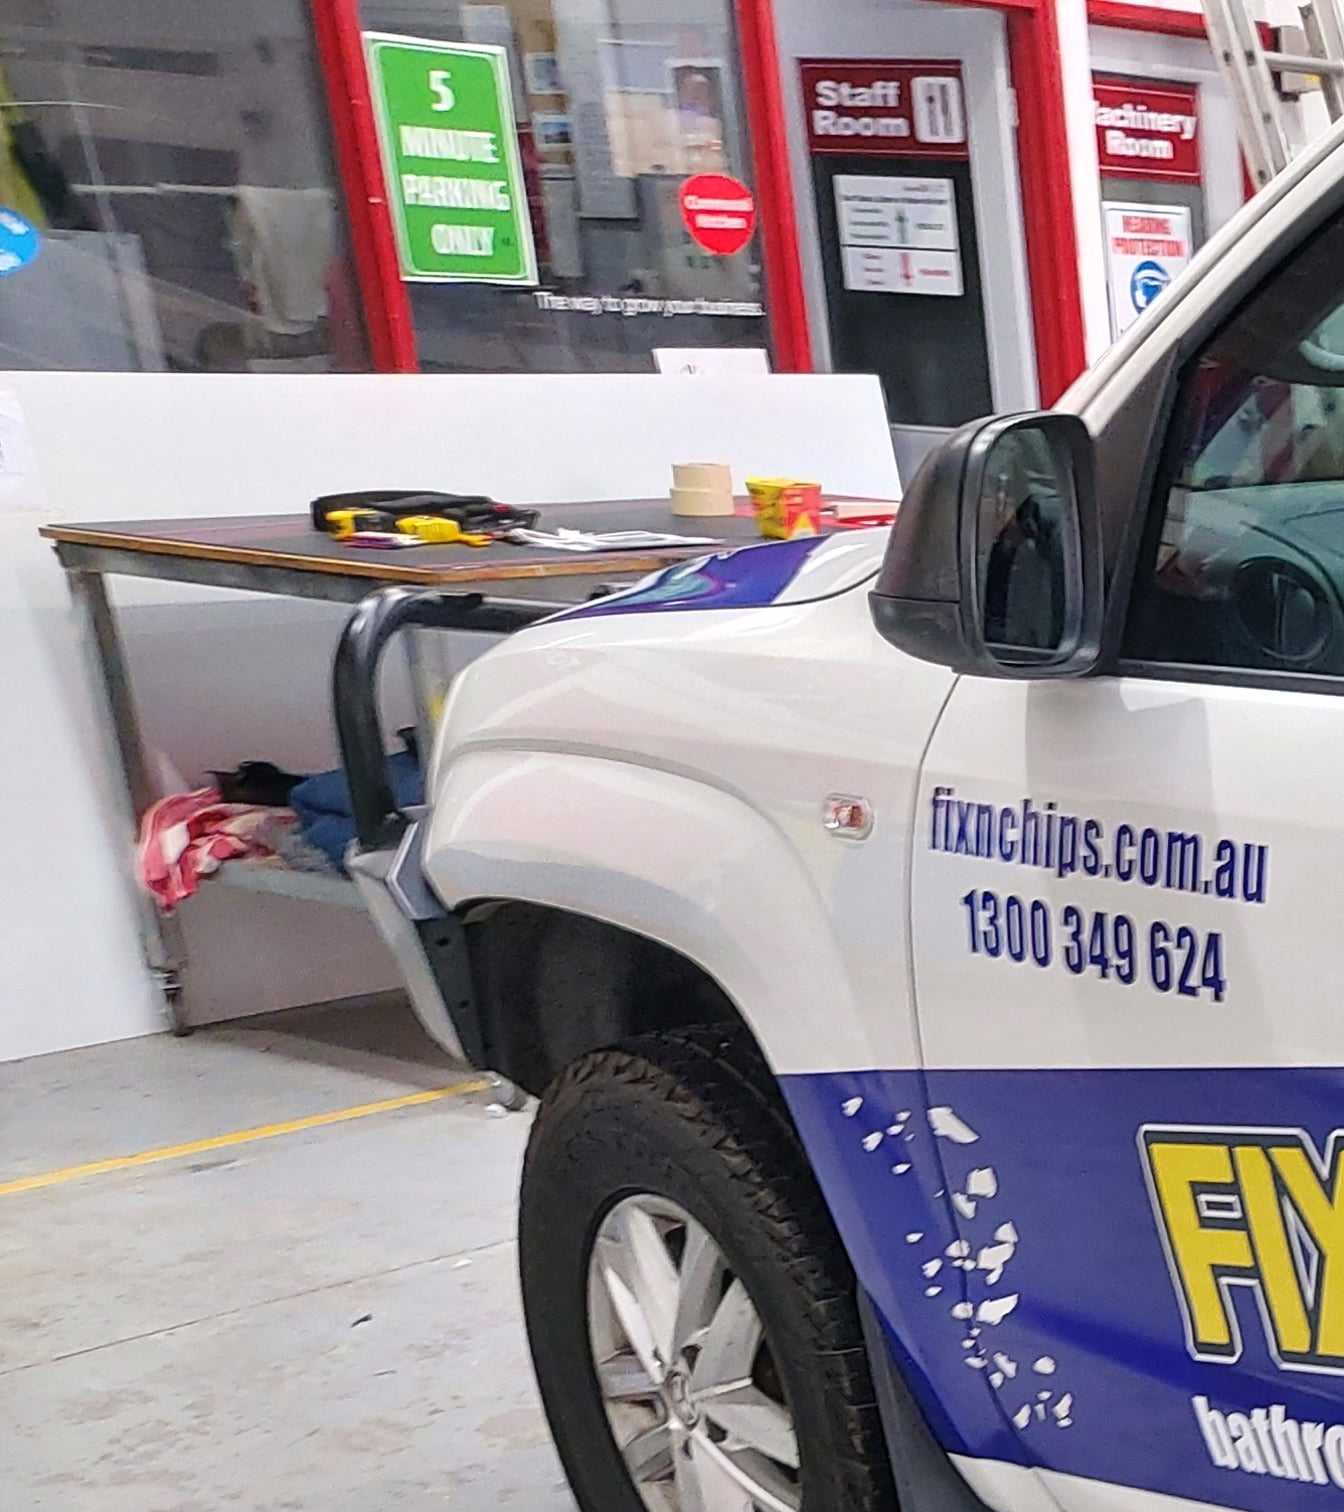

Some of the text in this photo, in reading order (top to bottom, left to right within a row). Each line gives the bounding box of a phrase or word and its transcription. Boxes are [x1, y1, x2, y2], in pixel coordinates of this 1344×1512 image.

[428, 70, 455, 112] 5
[815, 80, 900, 107] Staff
[812, 109, 910, 137] Room
[1092, 101, 1197, 140] achinery
[400, 125, 500, 163] MINUTE
[1105, 129, 1174, 160] Room
[401, 174, 511, 211] PARKING
[431, 223, 495, 256] ONLY
[929, 786, 1269, 904] fixnchips.com.au
[962, 888, 1228, 1003] 1300 349 624
